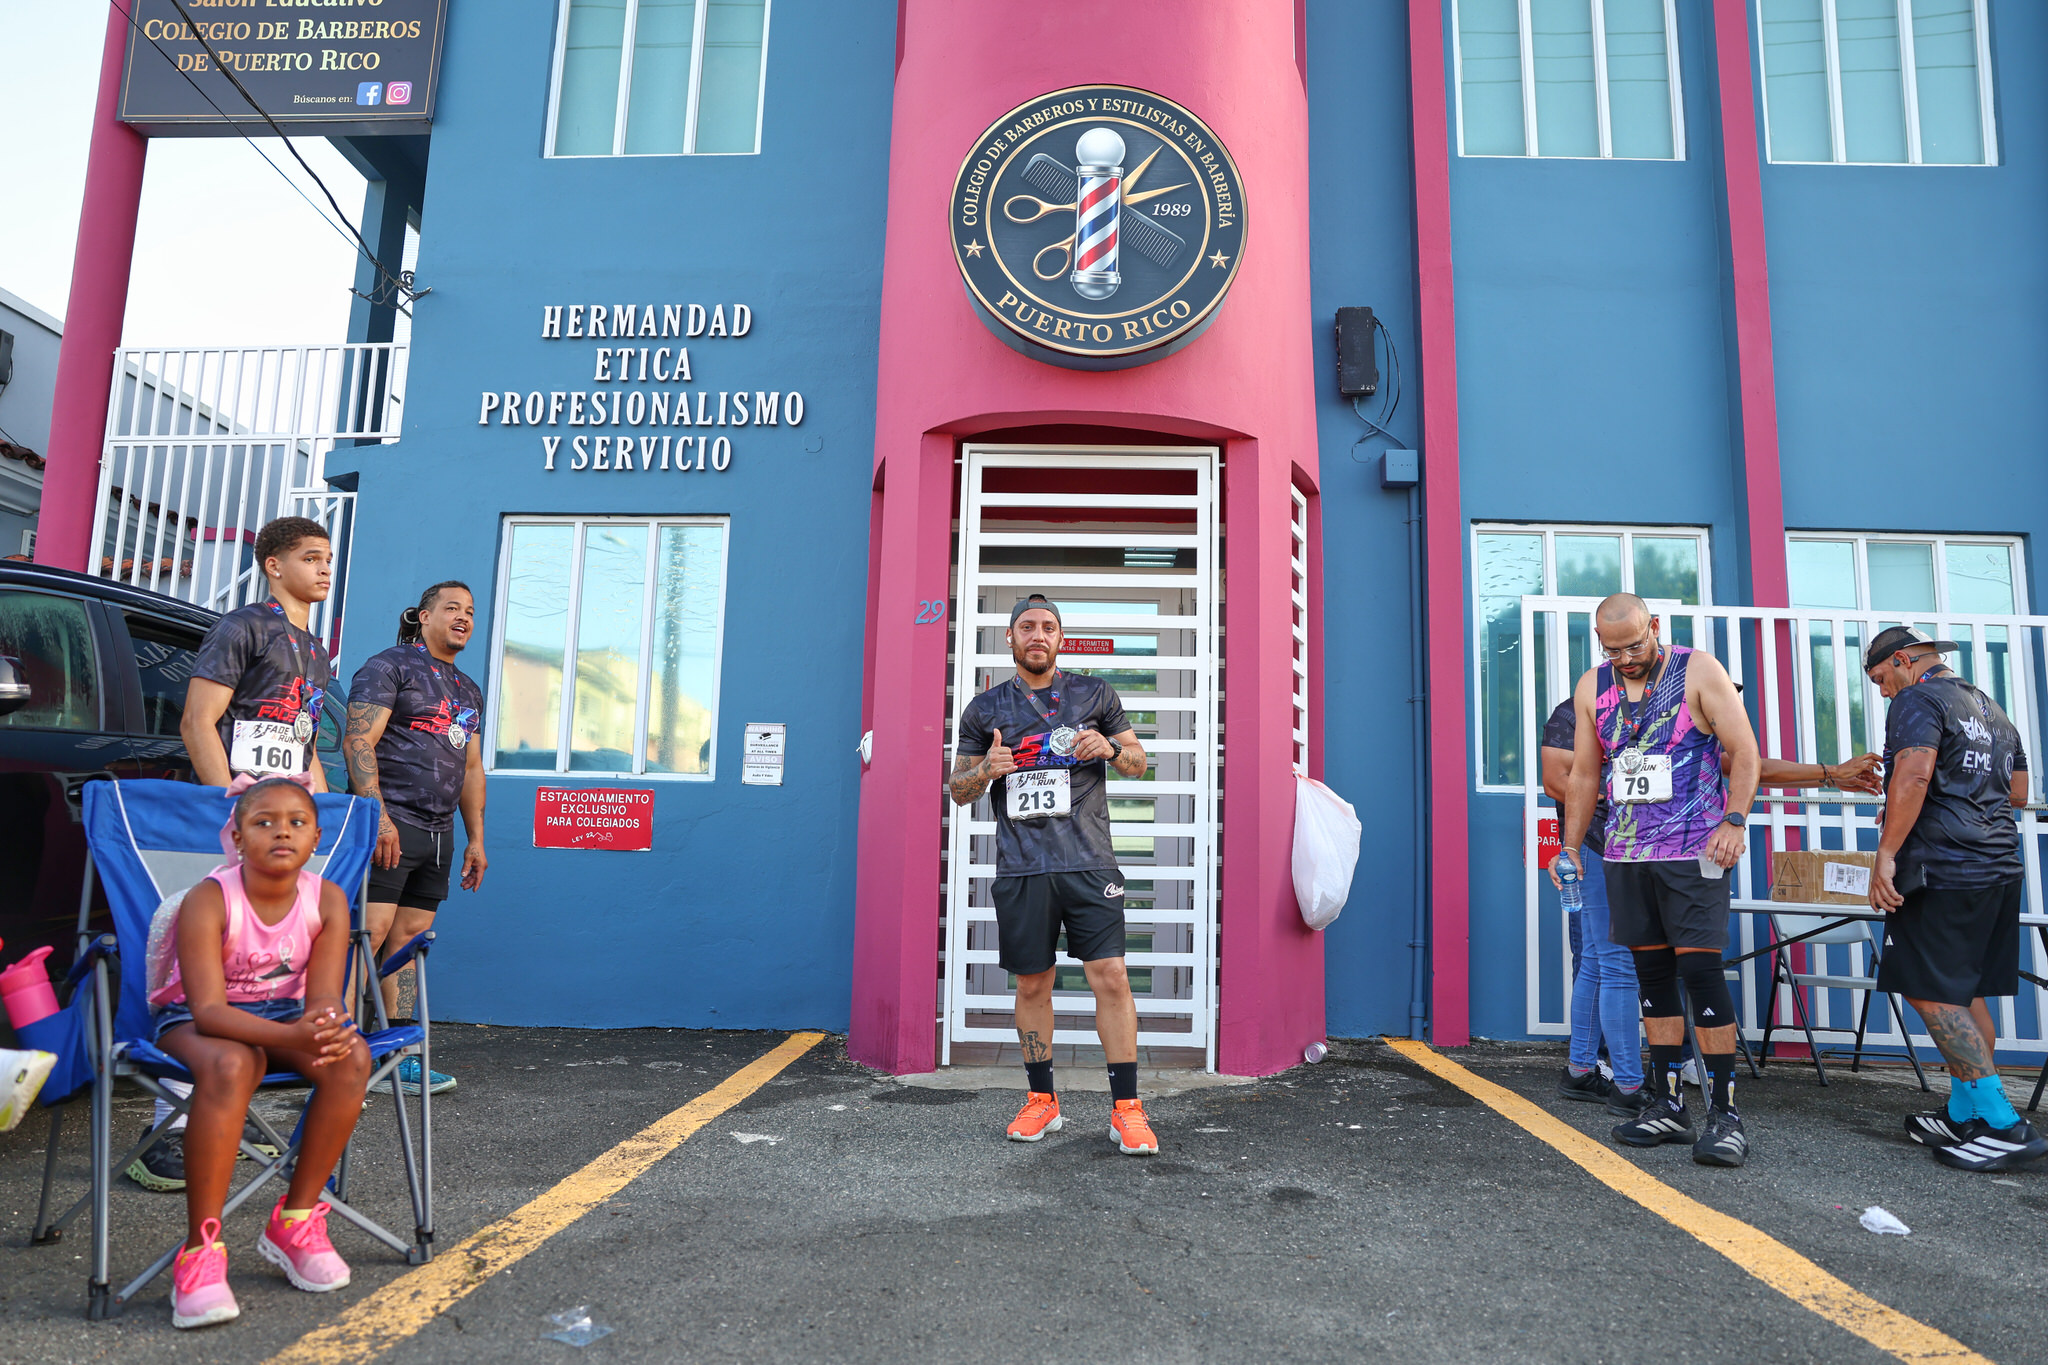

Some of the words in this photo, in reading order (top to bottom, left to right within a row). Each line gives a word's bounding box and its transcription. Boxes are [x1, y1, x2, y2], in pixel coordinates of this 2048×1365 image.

[144, 19, 251, 41] COLEGIO
[256, 22, 289, 40] DE
[296, 19, 422, 40] BARBEROS
[176, 53, 209, 72] DE
[215, 50, 313, 72] PUERTO
[319, 49, 381, 71] RICO
[293, 94, 336, 104] Búscanos
[338, 95, 353, 104] en:
[962, 158, 992, 227] COLEGIO
[985, 138, 1008, 161] DE
[1003, 98, 1085, 143] BARBEROS
[1087, 98, 1099, 111] Y
[1101, 98, 1188, 138] ESTILISTAS
[1183, 130, 1207, 154] EN
[1199, 151, 1236, 229] BARBERÍA
[1151, 202, 1192, 217] 1989
[541, 303, 752, 338] HERMANDAD
[996, 290, 1114, 343] PUERTO
[1121, 299, 1192, 341] RICO
[593, 347, 692, 382] ETICA
[478, 390, 805, 426] PROFESIONALISMO
[542, 436, 562, 470] Y
[570, 435, 733, 471] SERVICIO
[914, 599, 946, 625] 29
[257, 705, 300, 723] FADE
[265, 724, 290, 735] FADE
[409, 721, 450, 736] FADE
[278, 734, 296, 744] RUN
[252, 745, 292, 770] 160
[1014, 756, 1038, 767] DE
[1025, 771, 1048, 781] FADE
[1037, 778, 1057, 787] RUN
[1624, 776, 1650, 796] 79
[540, 791, 650, 804] ESTACIONAMIENTO
[1018, 790, 1056, 812] 213
[560, 803, 627, 815] EXCLUSIVO
[546, 816, 573, 827] PARA
[576, 817, 640, 829] COLEGIADOS
[571, 834, 584, 843] LEY
